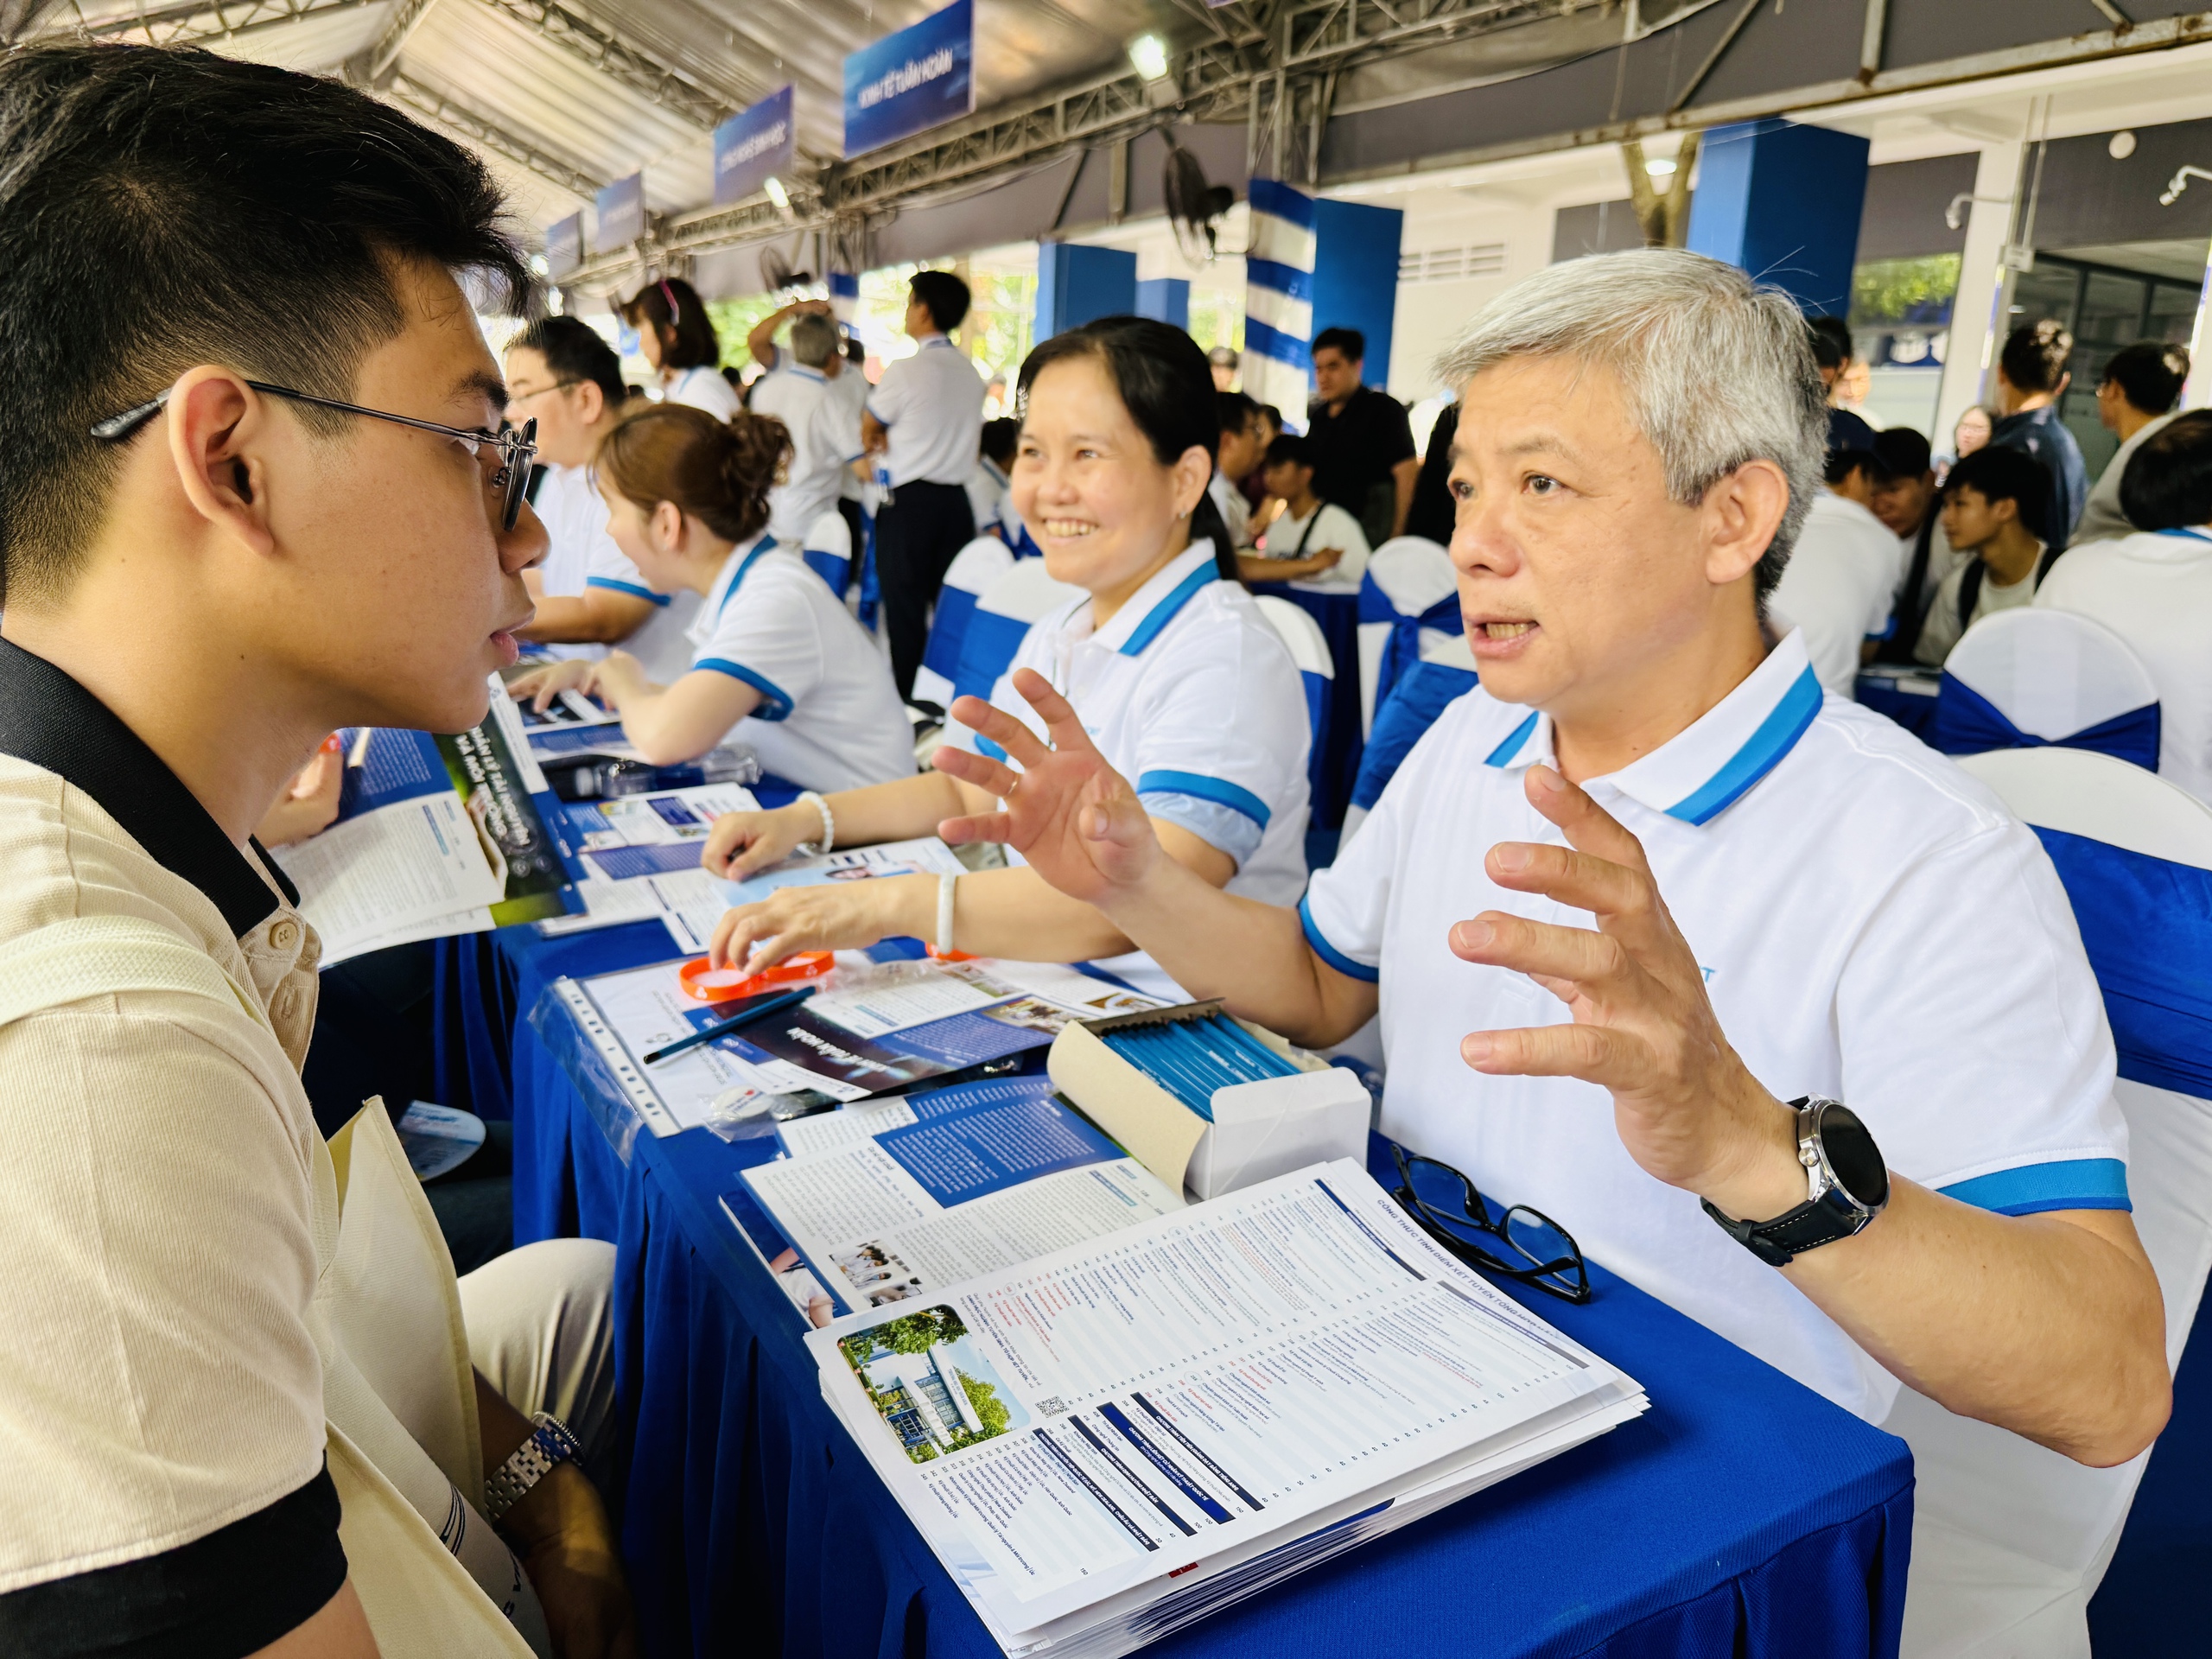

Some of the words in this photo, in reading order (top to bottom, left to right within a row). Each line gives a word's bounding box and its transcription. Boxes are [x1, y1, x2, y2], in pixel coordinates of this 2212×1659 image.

[454, 734, 475, 755] VÀ
[471, 726, 492, 756] UẢN
[464, 755, 486, 783] MÔI
[491, 772, 508, 792] TÀI
[476, 782, 507, 837] TRƯỜNG
[499, 793, 531, 845] NGUYÊN
[1377, 1198, 1398, 1219] CÔNG
[1397, 1217, 1419, 1238] THỨC
[1416, 1236, 1435, 1254] TÍNH
[1433, 1252, 1454, 1270] ĐIỂM
[1452, 1266, 1470, 1280] XÉT
[1468, 1277, 1496, 1300] TUYỂN
[1493, 1296, 1519, 1315] TỔNG
